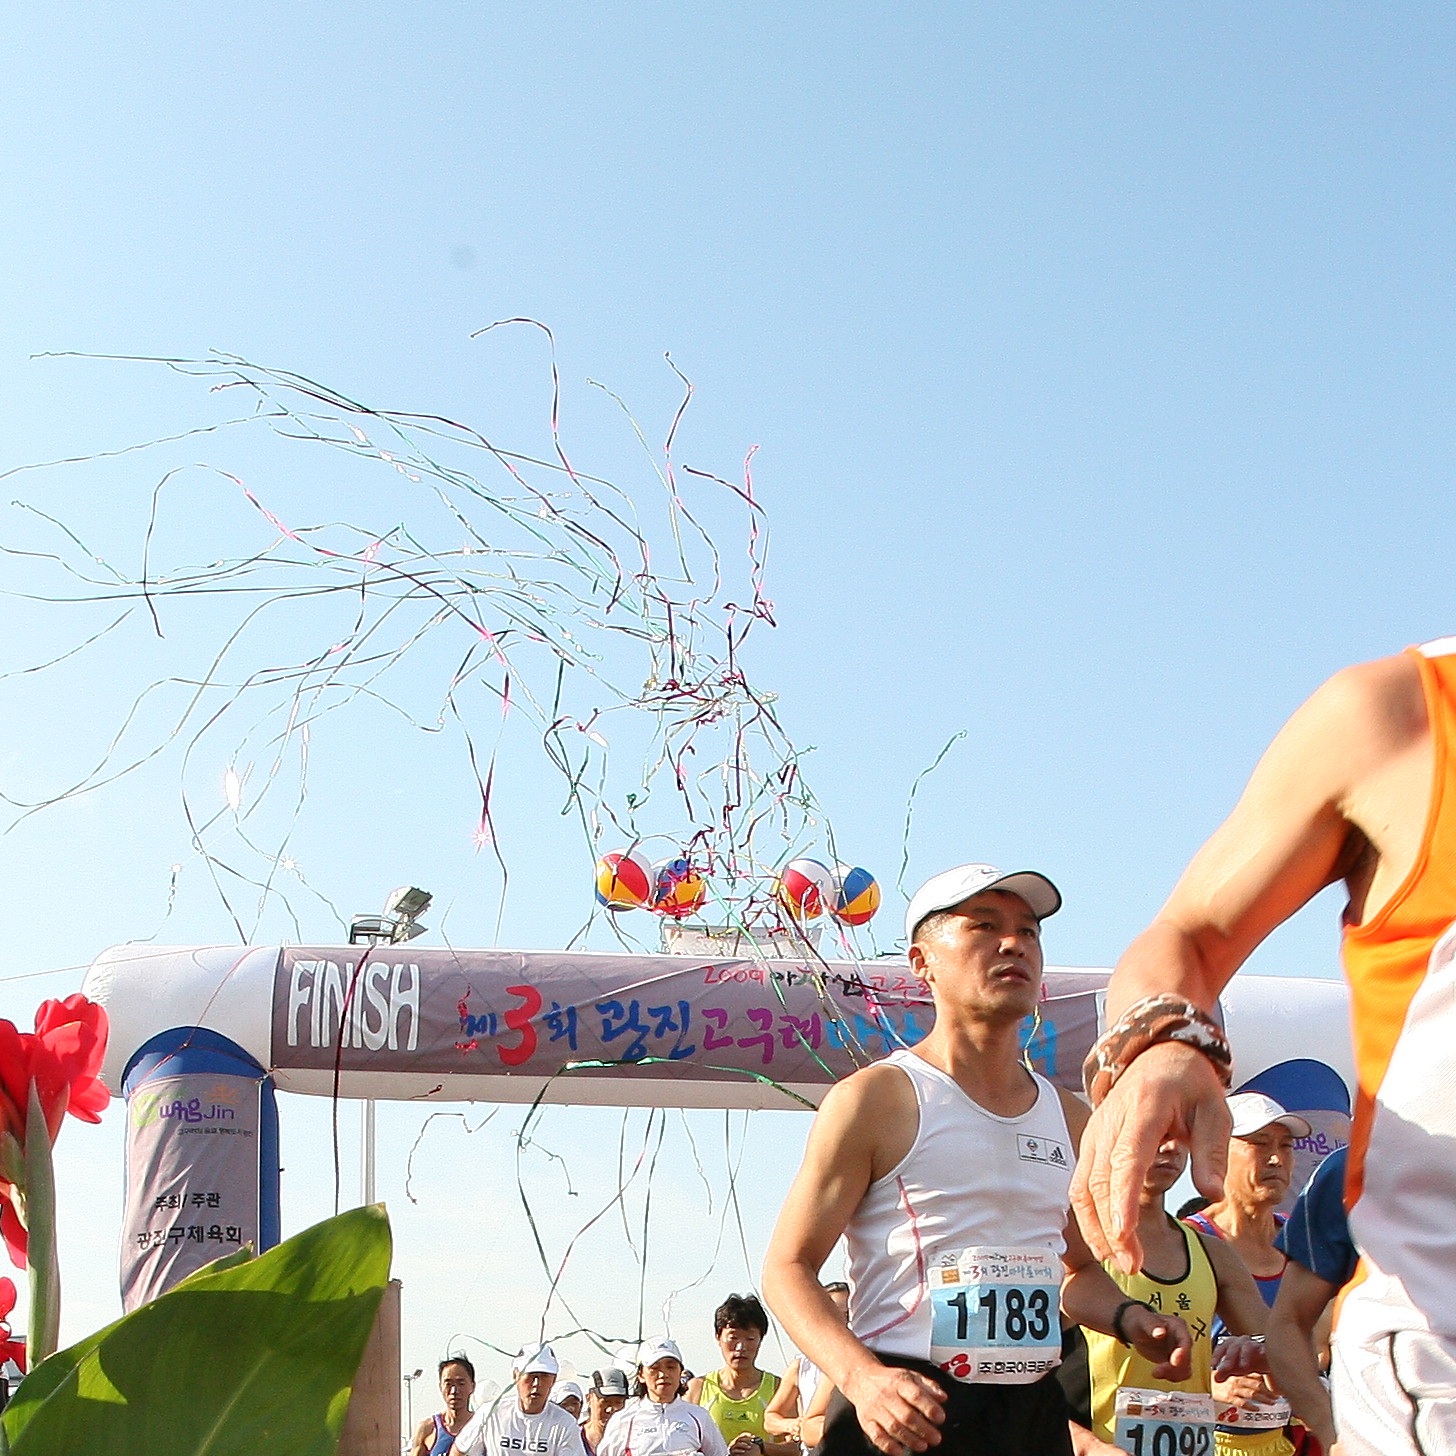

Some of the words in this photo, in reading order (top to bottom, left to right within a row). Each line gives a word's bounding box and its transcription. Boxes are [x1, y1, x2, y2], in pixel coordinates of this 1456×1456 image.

[703, 966, 766, 986] 2009
[287, 959, 420, 1051] FINISH
[191, 1192, 221, 1208] 주관
[136, 1224, 242, 1250] 광진구체육회
[947, 1288, 1050, 1341] 1183
[500, 1436, 548, 1453] asics
